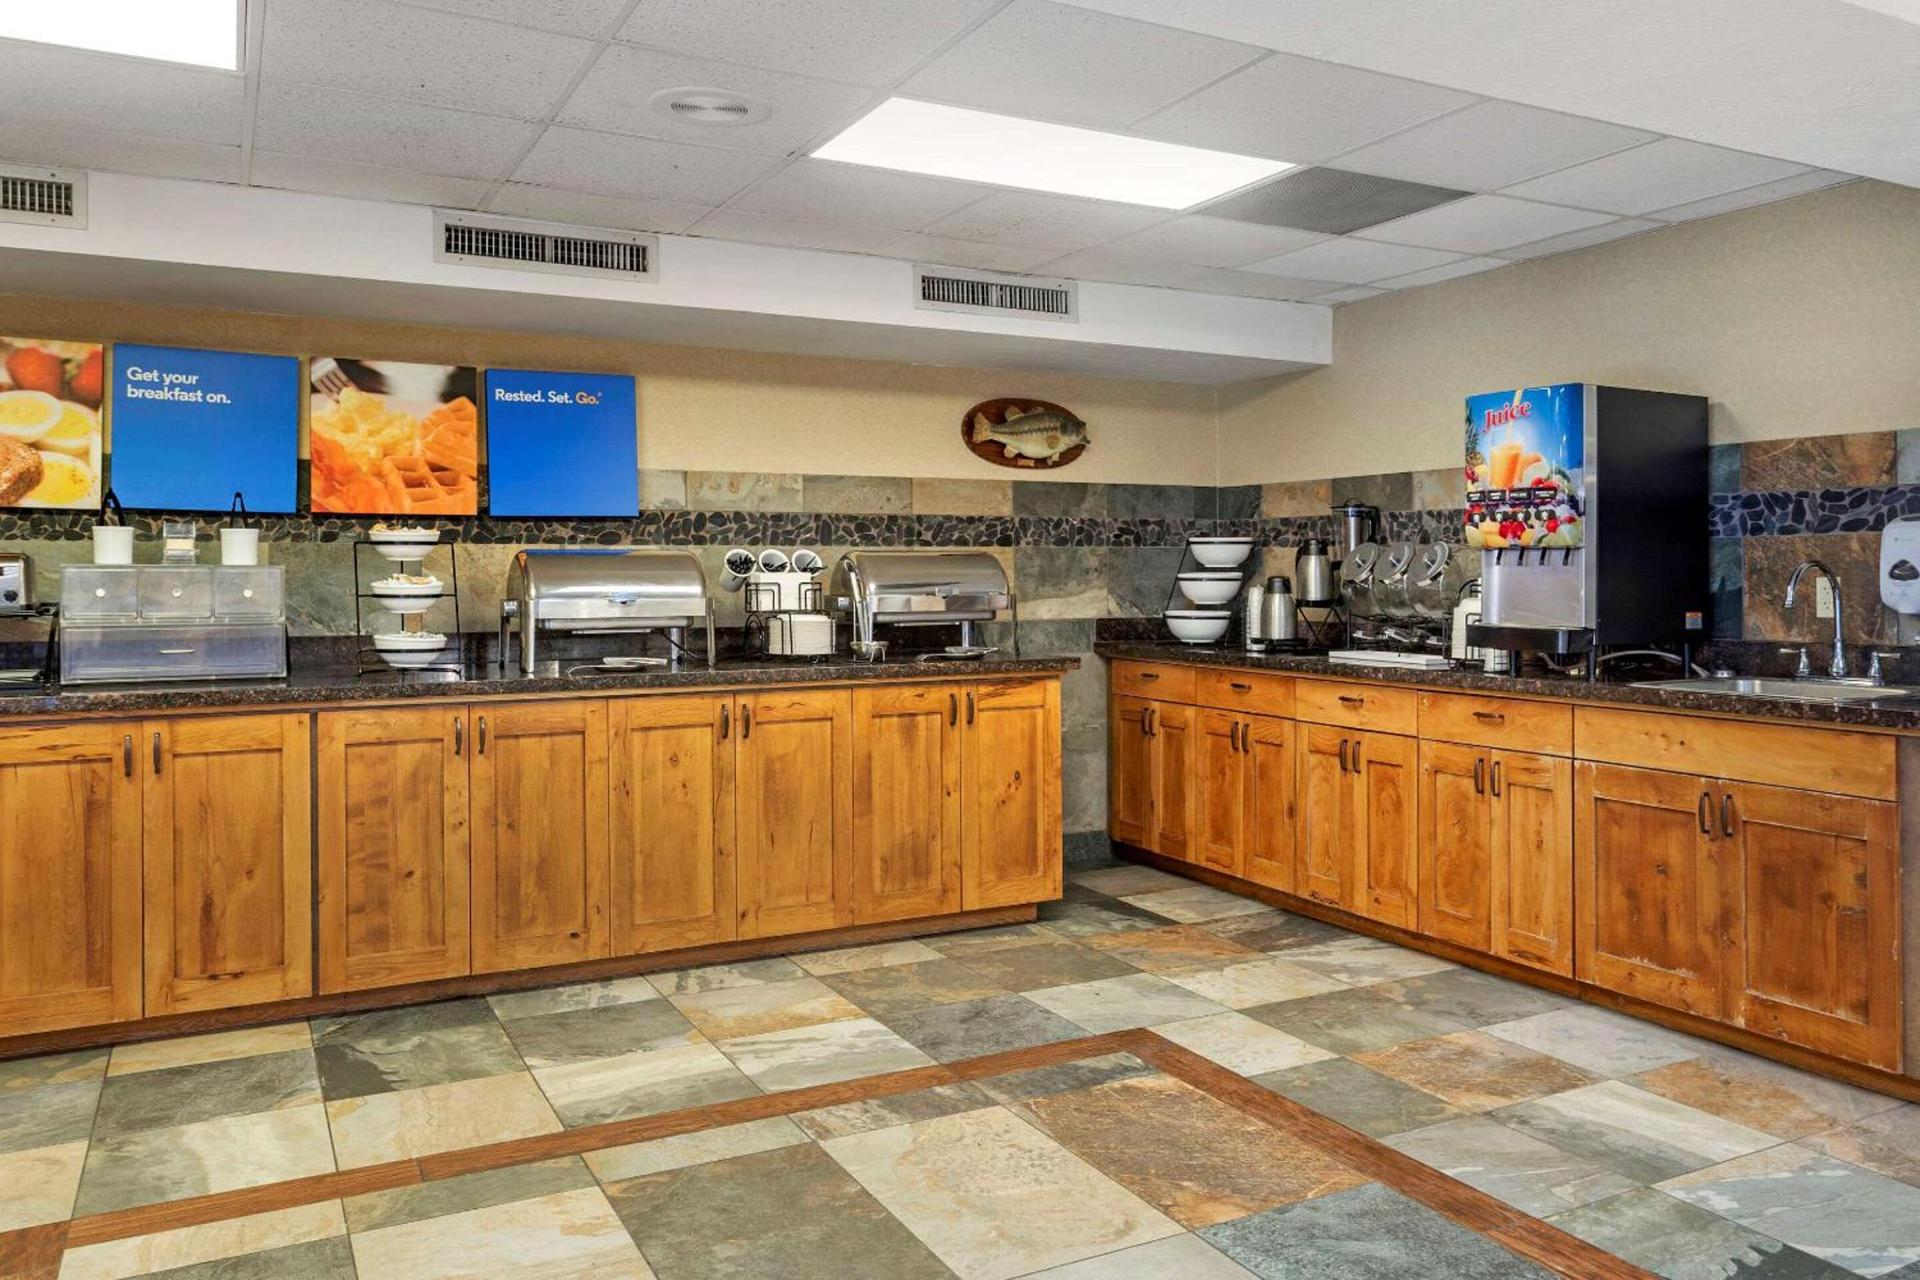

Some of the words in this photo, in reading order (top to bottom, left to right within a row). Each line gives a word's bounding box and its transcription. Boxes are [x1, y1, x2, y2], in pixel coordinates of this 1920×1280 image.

[126, 366, 159, 382] Get
[162, 373, 199, 385] your
[126, 383, 203, 402] breakfast
[205, 393, 231, 404] on.
[495, 388, 545, 403] Rested.
[547, 390, 573, 404] Set.
[1483, 402, 1532, 433] Juice
